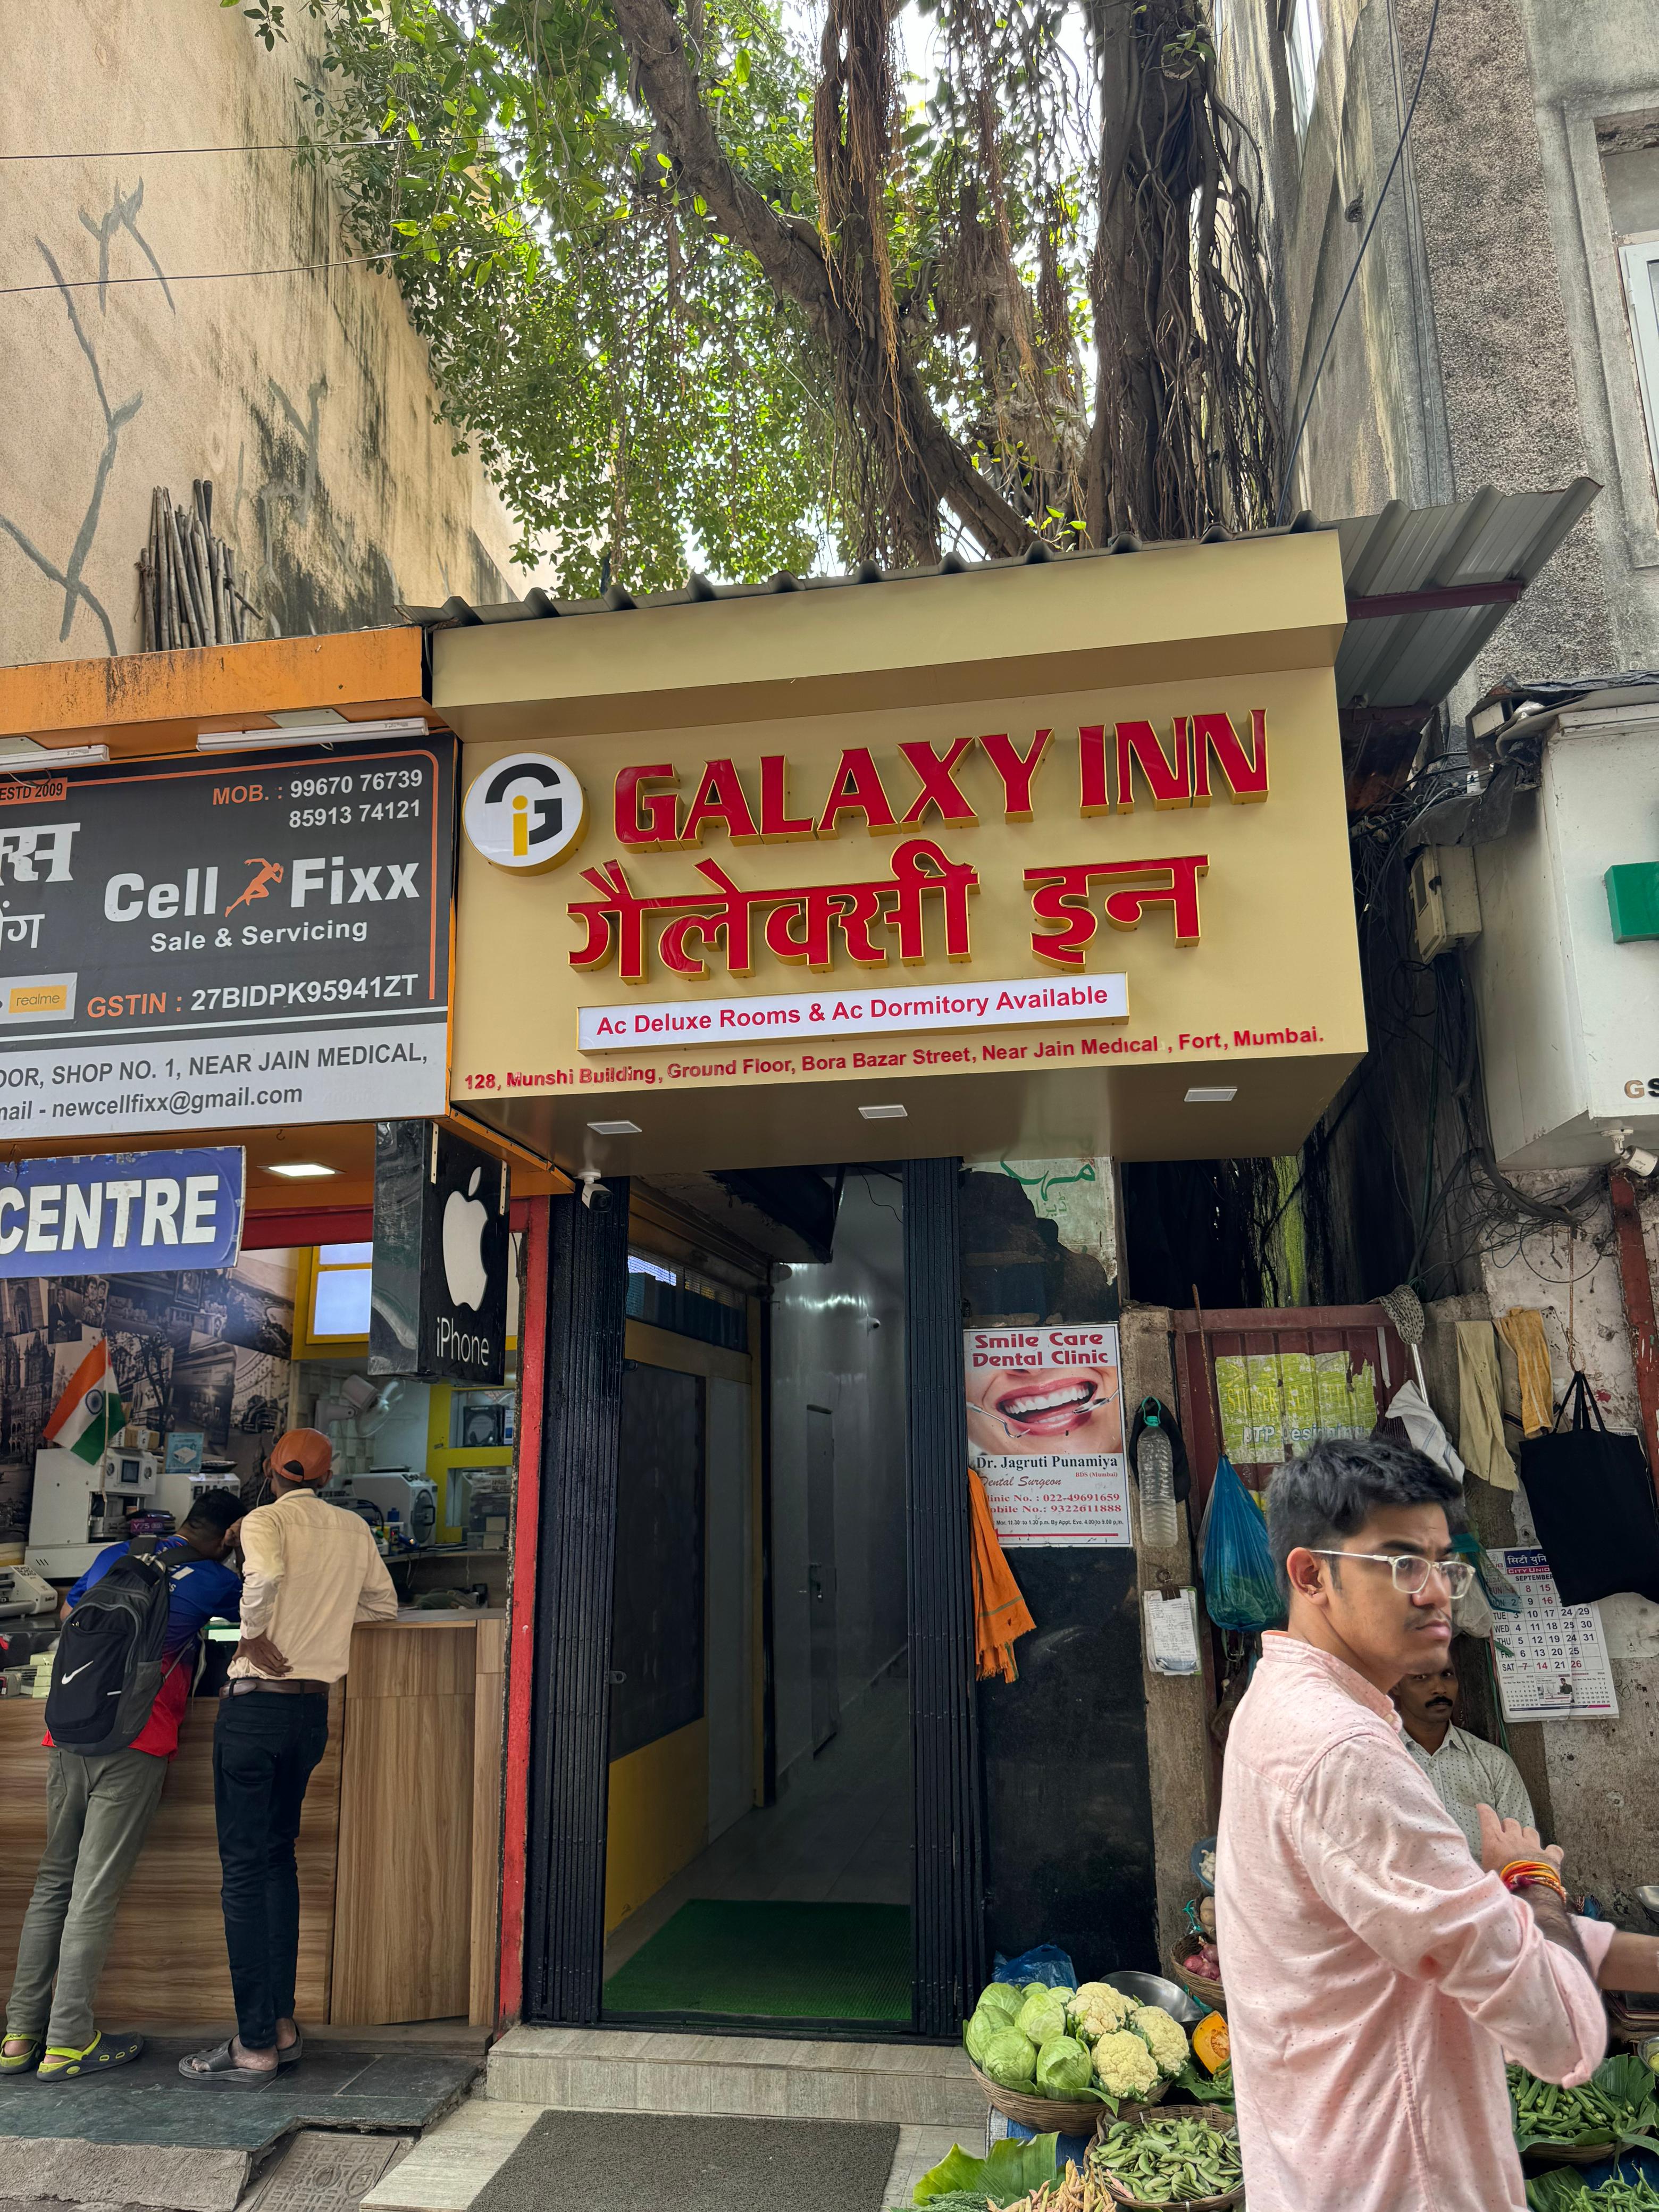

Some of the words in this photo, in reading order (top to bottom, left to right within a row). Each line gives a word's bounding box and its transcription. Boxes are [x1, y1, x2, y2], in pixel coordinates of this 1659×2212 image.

[35, 782, 63, 798] 2009
[213, 784, 270, 805] MOB.
[290, 775, 354, 798] 99670
[359, 769, 423, 792] 76739
[614, 727, 1055, 852] GALAXY
[1078, 708, 1270, 818] INN
[289, 805, 352, 828] 85913
[359, 799, 421, 823] 74121
[104, 867, 219, 923] Cell
[290, 856, 420, 908] Fixx
[566, 837, 981, 985] गैलेक्सी
[1023, 854, 1210, 973] इन
[150, 926, 207, 953] Sale
[214, 927, 233, 948] &
[241, 919, 368, 946] Servicing
[16, 992, 61, 1007] realme
[87, 992, 167, 1018] GSTIN
[191, 974, 418, 1012] 27BIDPK95941ZT
[596, 1017, 627, 1035] Ac
[634, 1011, 711, 1033] Deluxe
[719, 1008, 800, 1027] Rooms
[809, 1004, 825, 1021] &
[832, 1002, 863, 1020] Ac
[870, 988, 988, 1018] Dormitory
[996, 986, 1108, 1011] Available
[52, 1063, 113, 1085] SHOP
[119, 1060, 157, 1081] NO.
[166, 1058, 181, 1081] 1,
[189, 1053, 253, 1077] NEAR
[258, 1049, 310, 1072] JAIN
[317, 1042, 428, 1070] MEDICAL,
[465, 1073, 501, 1092] 128,
[507, 1068, 574, 1088] Munshi
[579, 1065, 663, 1085] Building,
[667, 1060, 738, 1080] Ground
[743, 1057, 795, 1077] Floor,
[802, 1053, 847, 1071] Bora
[853, 1050, 907, 1069] Bazar
[912, 1045, 976, 1066] Street,
[982, 1043, 1027, 1062] Near
[1038, 1040, 1075, 1058] Jain
[1081, 1036, 1158, 1055] Medical
[1179, 1032, 1228, 1052] Fort,
[1234, 1026, 1324, 1048] Mumbai.
[52, 1086, 303, 1119] newcellfixx@gmail.com
[0, 1175, 219, 1255] CENTRE
[436, 1317, 490, 1366] iPhone
[975, 1333, 1039, 1349] Smile
[1049, 1331, 1103, 1346] Care
[973, 1351, 1043, 1368] Dental
[1051, 1349, 1108, 1364] Clinic
[976, 1457, 997, 1469] Dr.
[1001, 1456, 1048, 1470] Jagruti
[1052, 1455, 1118, 1470] Punamiya
[1018, 1476, 1062, 1489] Surgeon
[990, 1505, 1018, 1513] obile
[1051, 1504, 1121, 1513] 9322611888
[1043, 1493, 1120, 1503] 022-49691659
[1506, 1555, 1528, 1565] सिटी
[1493, 1612, 1507, 1620] TUE
[1494, 1624, 1510, 1633] WED
[1497, 1637, 1511, 1646] THU
